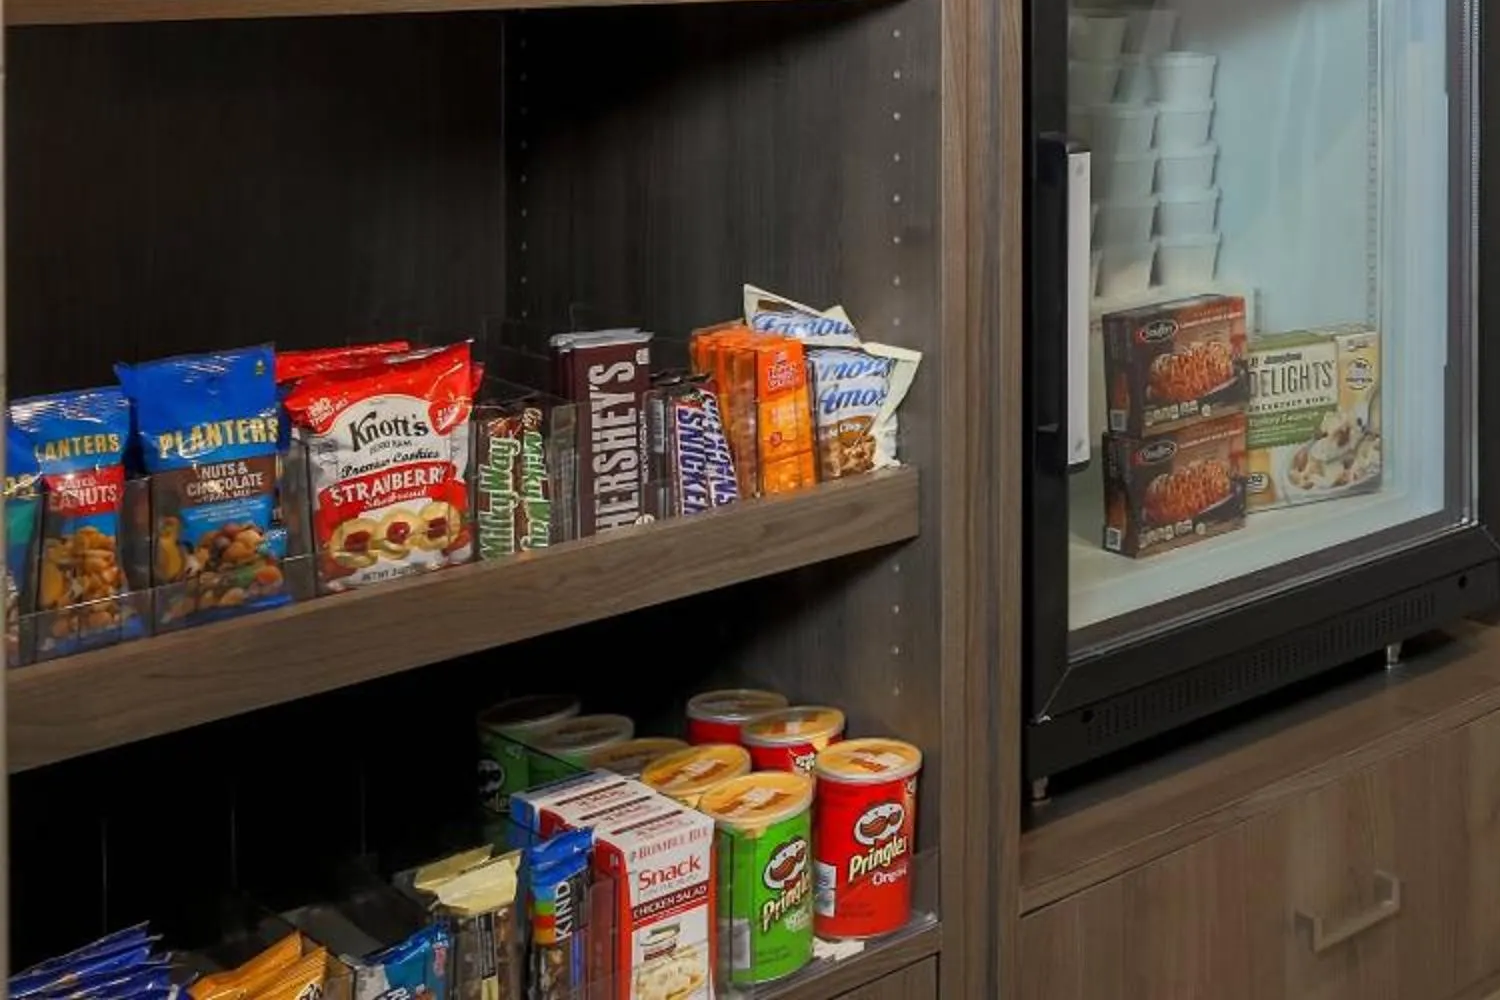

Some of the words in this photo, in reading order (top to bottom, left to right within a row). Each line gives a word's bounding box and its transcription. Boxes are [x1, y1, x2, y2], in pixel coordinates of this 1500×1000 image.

[1250, 359, 1333, 398] DELIGHTS
[35, 433, 121, 460] LANTERS
[159, 417, 279, 459] PLANTERS
[348, 410, 430, 452] Knott's
[588, 361, 640, 534] HERSHEY'S
[187, 471, 264, 497] CHOCOLATE
[201, 462, 236, 479] NUTS
[330, 465, 448, 506] STRAWBERRY
[638, 854, 702, 891] Snack
[555, 881, 573, 941] KIND
[633, 897, 675, 920] CHICKEN
[676, 885, 708, 906] SALAD
